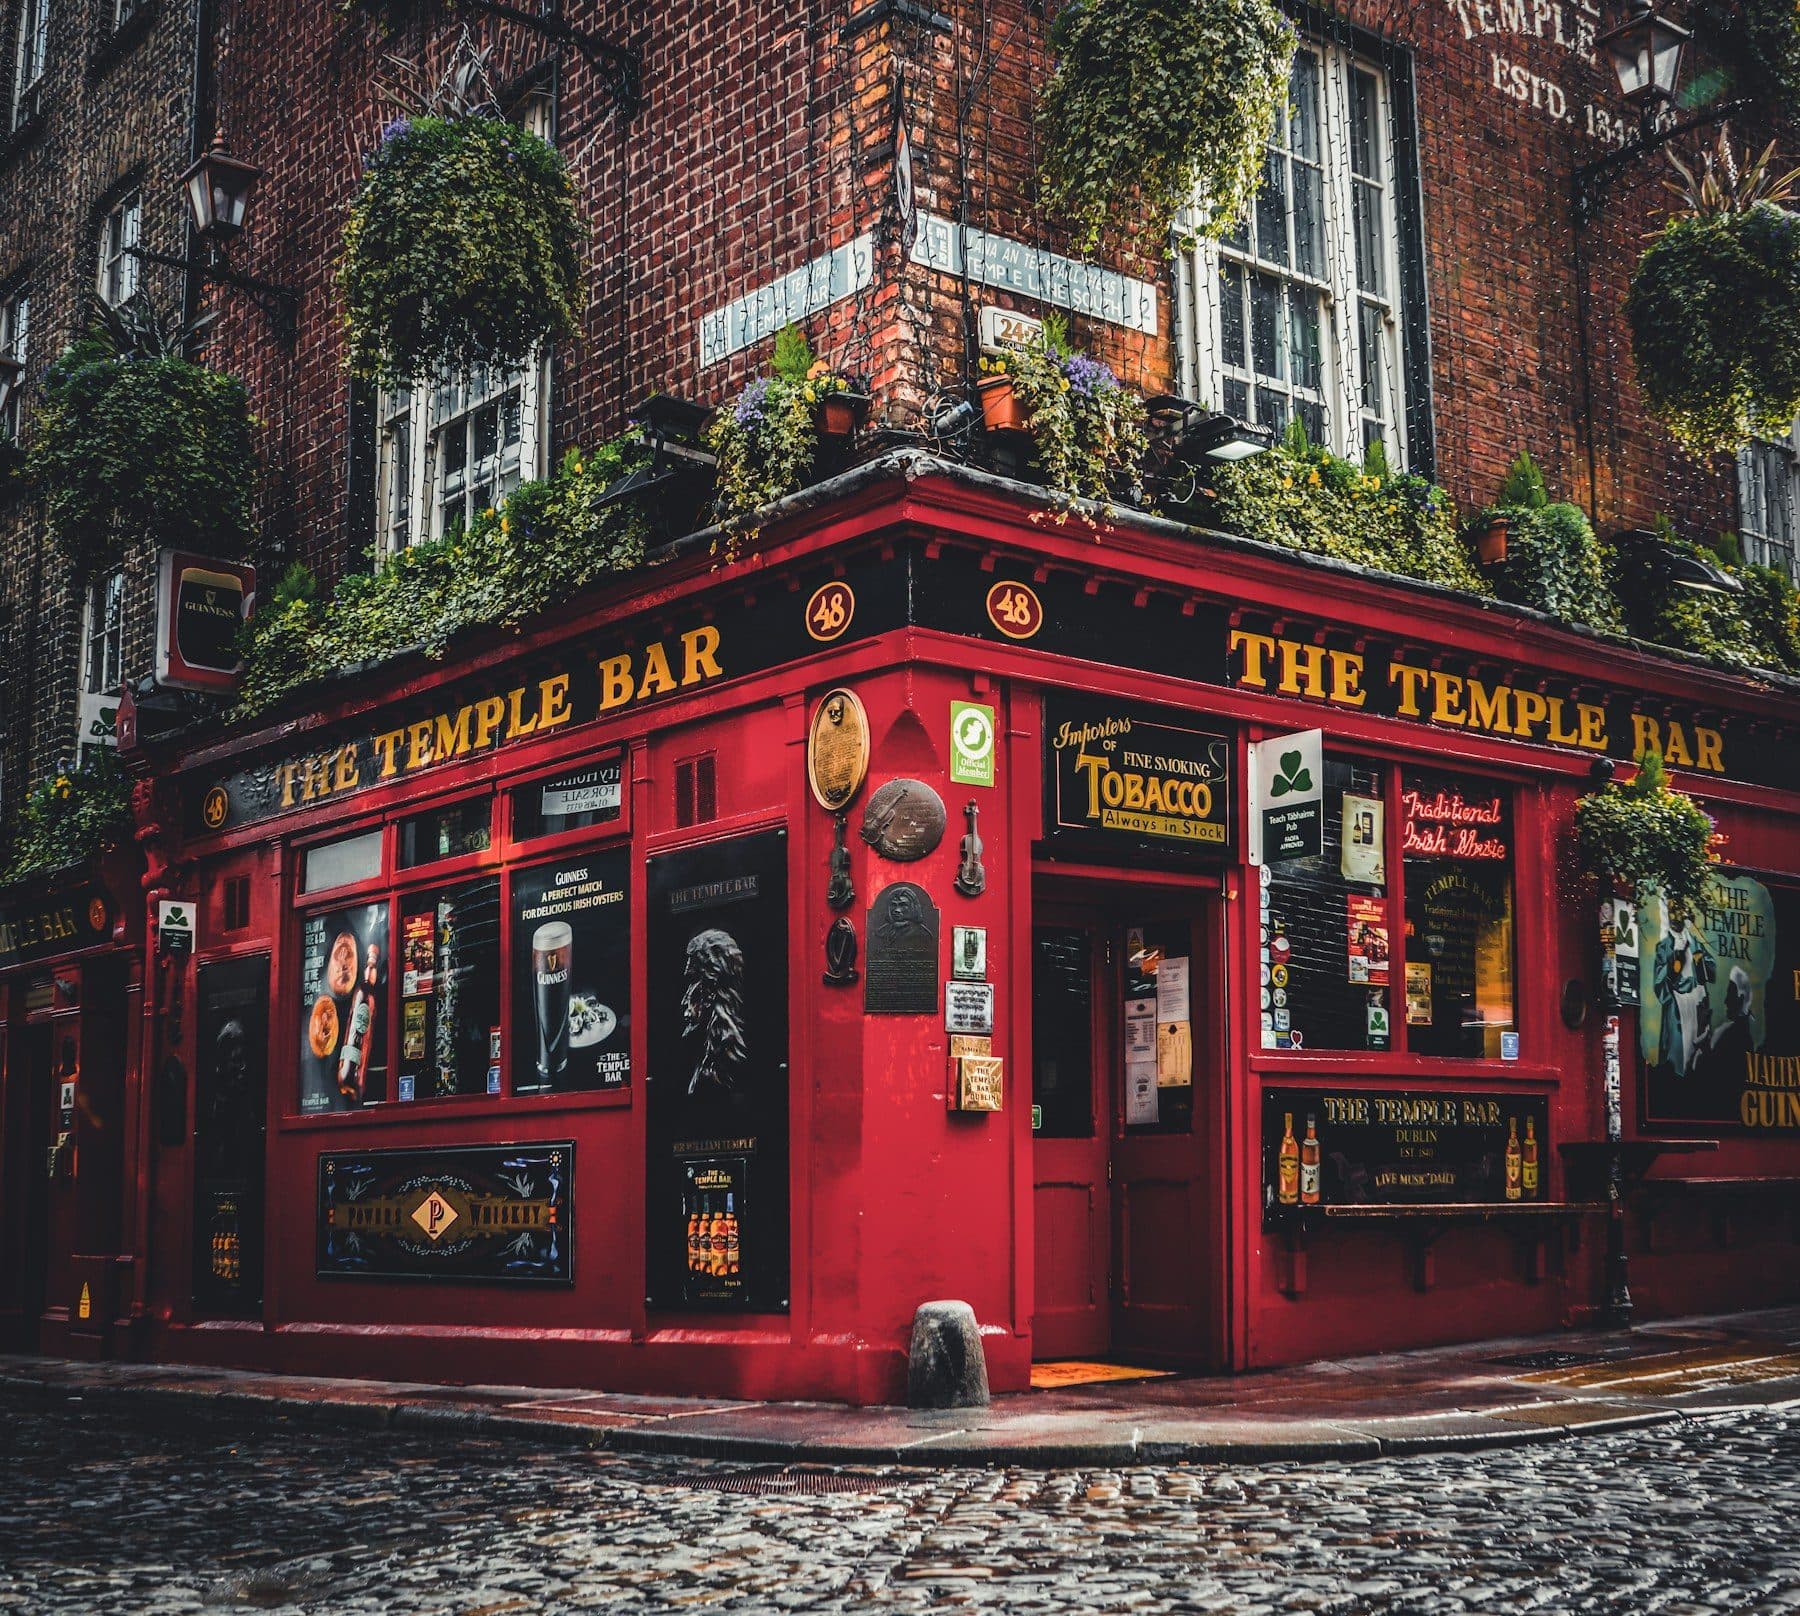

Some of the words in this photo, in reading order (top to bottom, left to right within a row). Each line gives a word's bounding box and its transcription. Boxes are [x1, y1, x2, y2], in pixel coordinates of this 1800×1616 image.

[1448, 0, 1597, 66] TEMPLE
[854, 250, 867, 278] 2
[1002, 247, 1020, 265] AN
[967, 256, 1023, 288] TEMPLE
[1072, 289, 1122, 320] SOUTH
[749, 299, 797, 337] TEMPLE
[185, 601, 237, 618] GUINNESS
[814, 592, 848, 632] 48
[995, 588, 1032, 626] 48
[1229, 628, 1368, 707] THE
[1389, 661, 1610, 751] TEMPLE
[1631, 713, 1727, 773] BAR
[276, 743, 362, 809] THE
[374, 672, 574, 778] TEMPLE
[599, 624, 724, 711] BAR
[1052, 716, 1132, 757] Importers
[1102, 739, 1117, 752] OF
[1123, 751, 1153, 774] FINE
[1153, 758, 1212, 783] SMOKING
[1075, 753, 1213, 819] TOBACCO
[207, 795, 224, 823] 48
[1402, 791, 1502, 824] Traditional
[1104, 810, 1157, 831] Always
[1164, 815, 1178, 834] in
[1182, 818, 1224, 840] Stock
[1286, 822, 1298, 831] Pub
[1402, 820, 1446, 853] Irish
[547, 886, 578, 902] PERFECT
[577, 880, 602, 895] MATCH
[555, 868, 588, 886] GUINNESS
[1424, 873, 1472, 901] TEMPLE
[522, 908, 537, 921] FOR
[536, 901, 573, 918] DELICIOUS
[572, 896, 592, 911] IRISH
[592, 890, 624, 907] OYSTERS
[1717, 883, 1749, 912] THE
[1703, 908, 1765, 938] TEMPLE
[1718, 934, 1753, 962] BAR
[537, 969, 568, 985] GUINNESS
[596, 1058, 631, 1073] TEMPLE
[605, 1071, 622, 1083] BAR
[1323, 1096, 1369, 1125] THE
[1374, 1098, 1458, 1126] TEMPLE
[1462, 1100, 1503, 1127] BAR
[1396, 1129, 1438, 1143] DUBLIN
[1375, 1172, 1398, 1187] LIVE
[470, 1204, 542, 1227] WHISKEY
